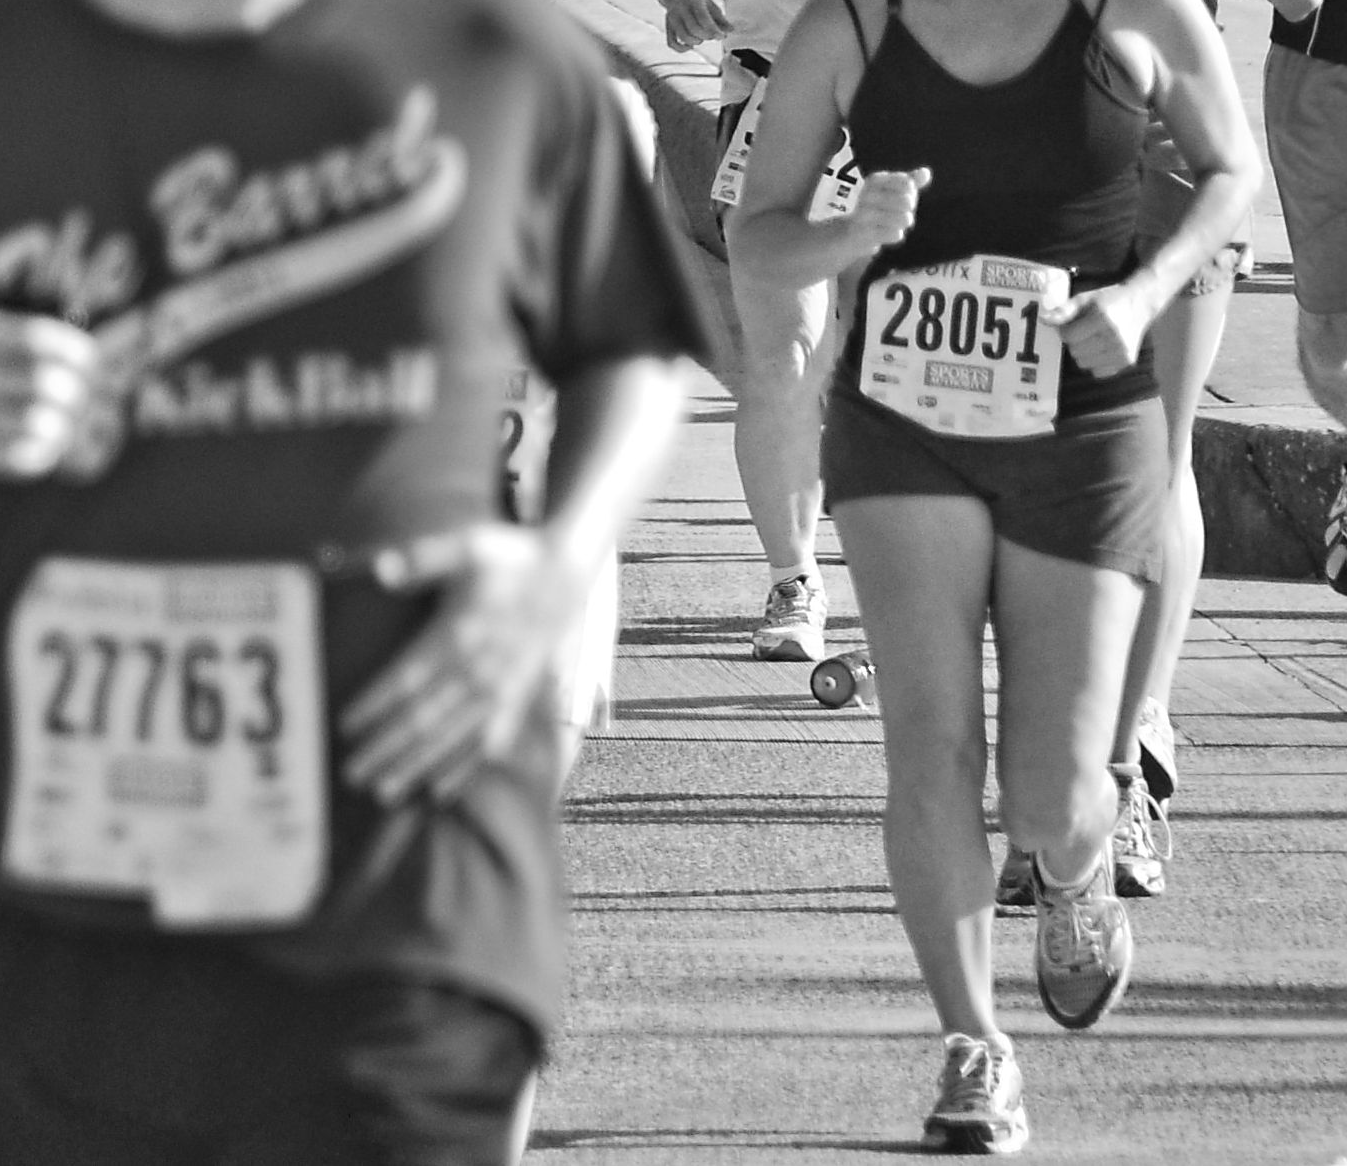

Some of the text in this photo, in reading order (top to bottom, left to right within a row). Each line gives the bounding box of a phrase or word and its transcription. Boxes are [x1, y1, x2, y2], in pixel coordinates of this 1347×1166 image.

[880, 283, 1041, 364] 28051
[928, 365, 990, 384] SPORTS
[37, 628, 285, 752] 27763
